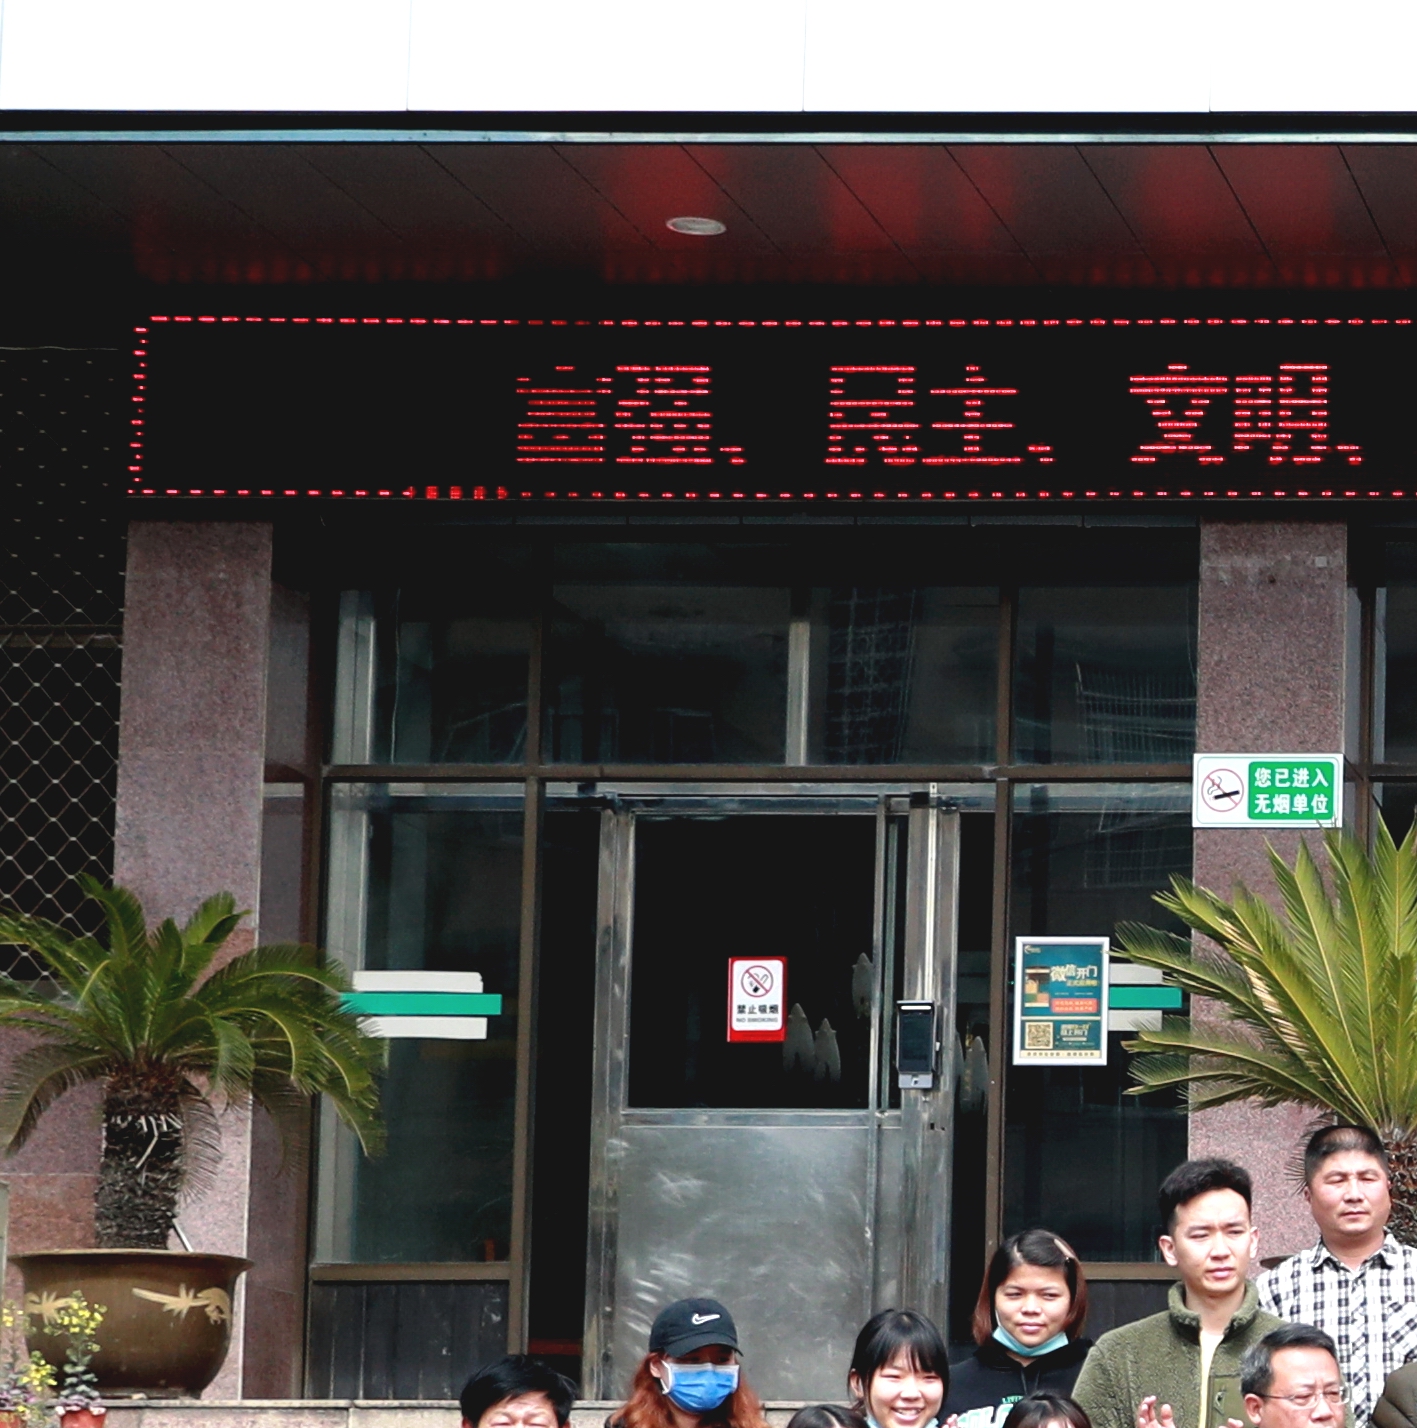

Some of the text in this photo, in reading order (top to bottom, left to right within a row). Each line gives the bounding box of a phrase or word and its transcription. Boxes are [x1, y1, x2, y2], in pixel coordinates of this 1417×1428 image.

[1254, 767, 1329, 788] 您已进入
[1254, 794, 1329, 814] 无烟单位
[737, 1004, 779, 1015] 禁止吸烟
